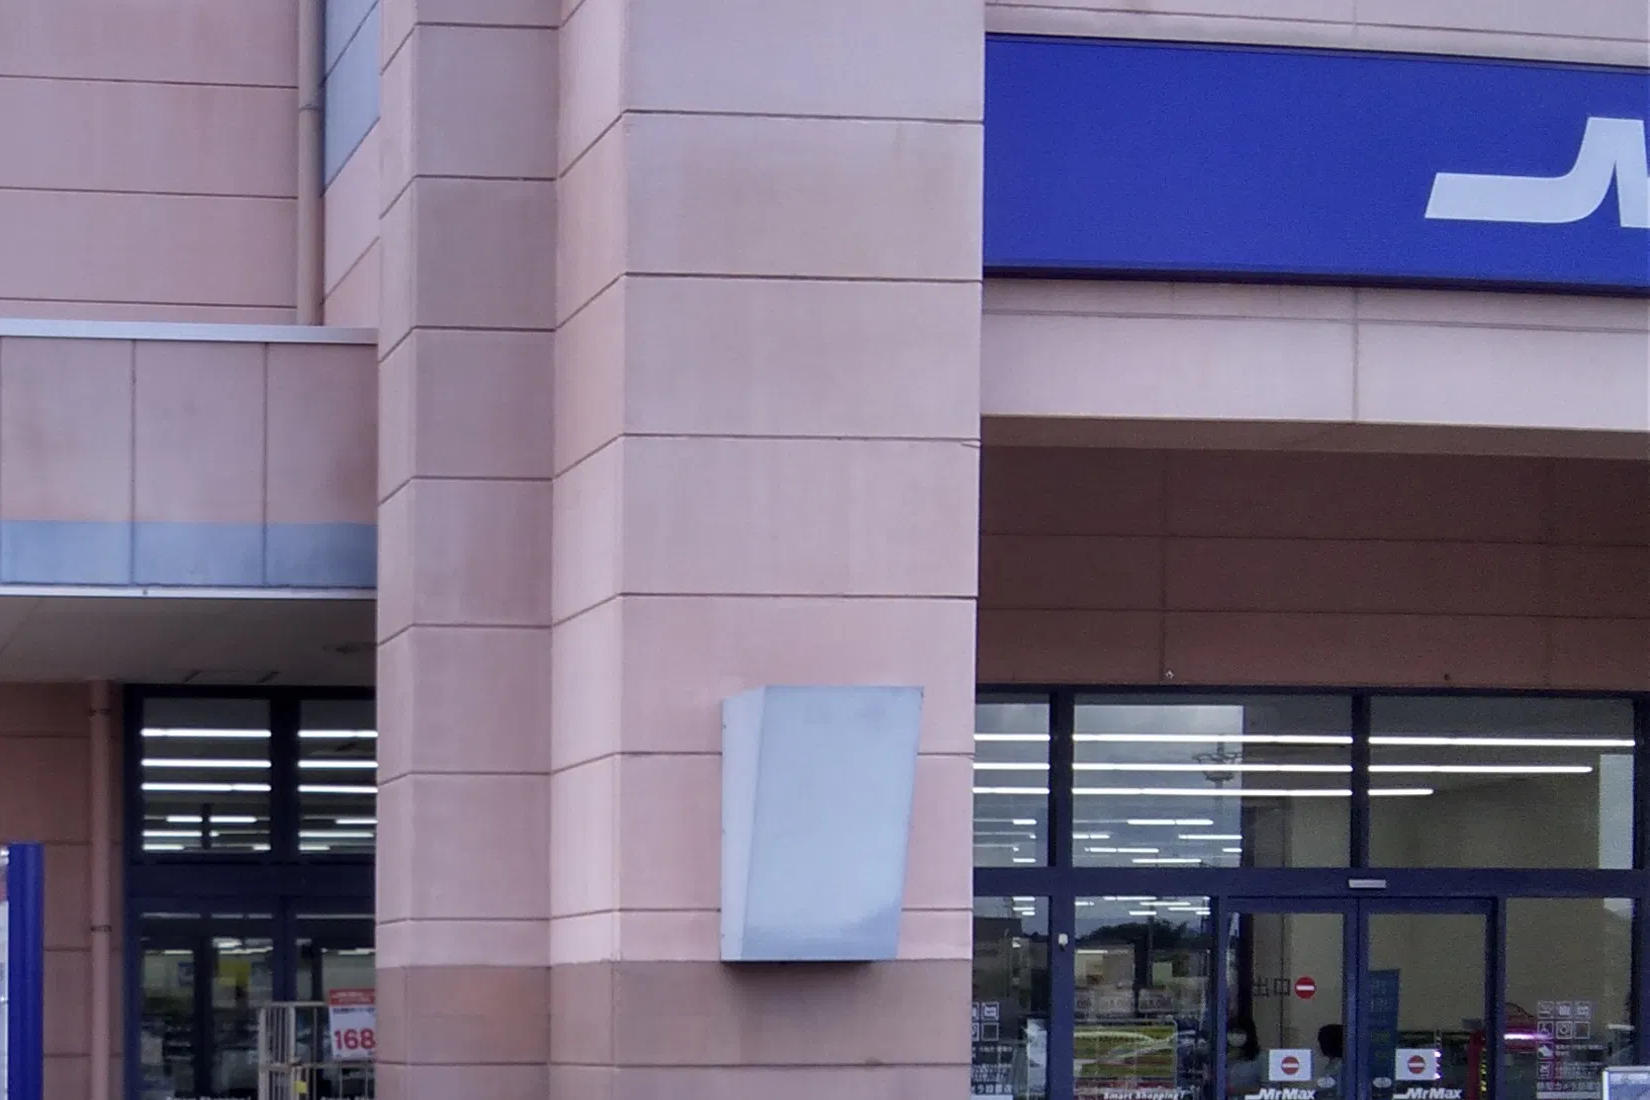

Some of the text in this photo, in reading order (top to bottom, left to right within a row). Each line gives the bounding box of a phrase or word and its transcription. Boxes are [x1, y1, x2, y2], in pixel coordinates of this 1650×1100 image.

[334, 1028, 375, 1050] 168
[1244, 1087, 1316, 1100] MrMax
[1392, 1086, 1463, 1100] MrMax
